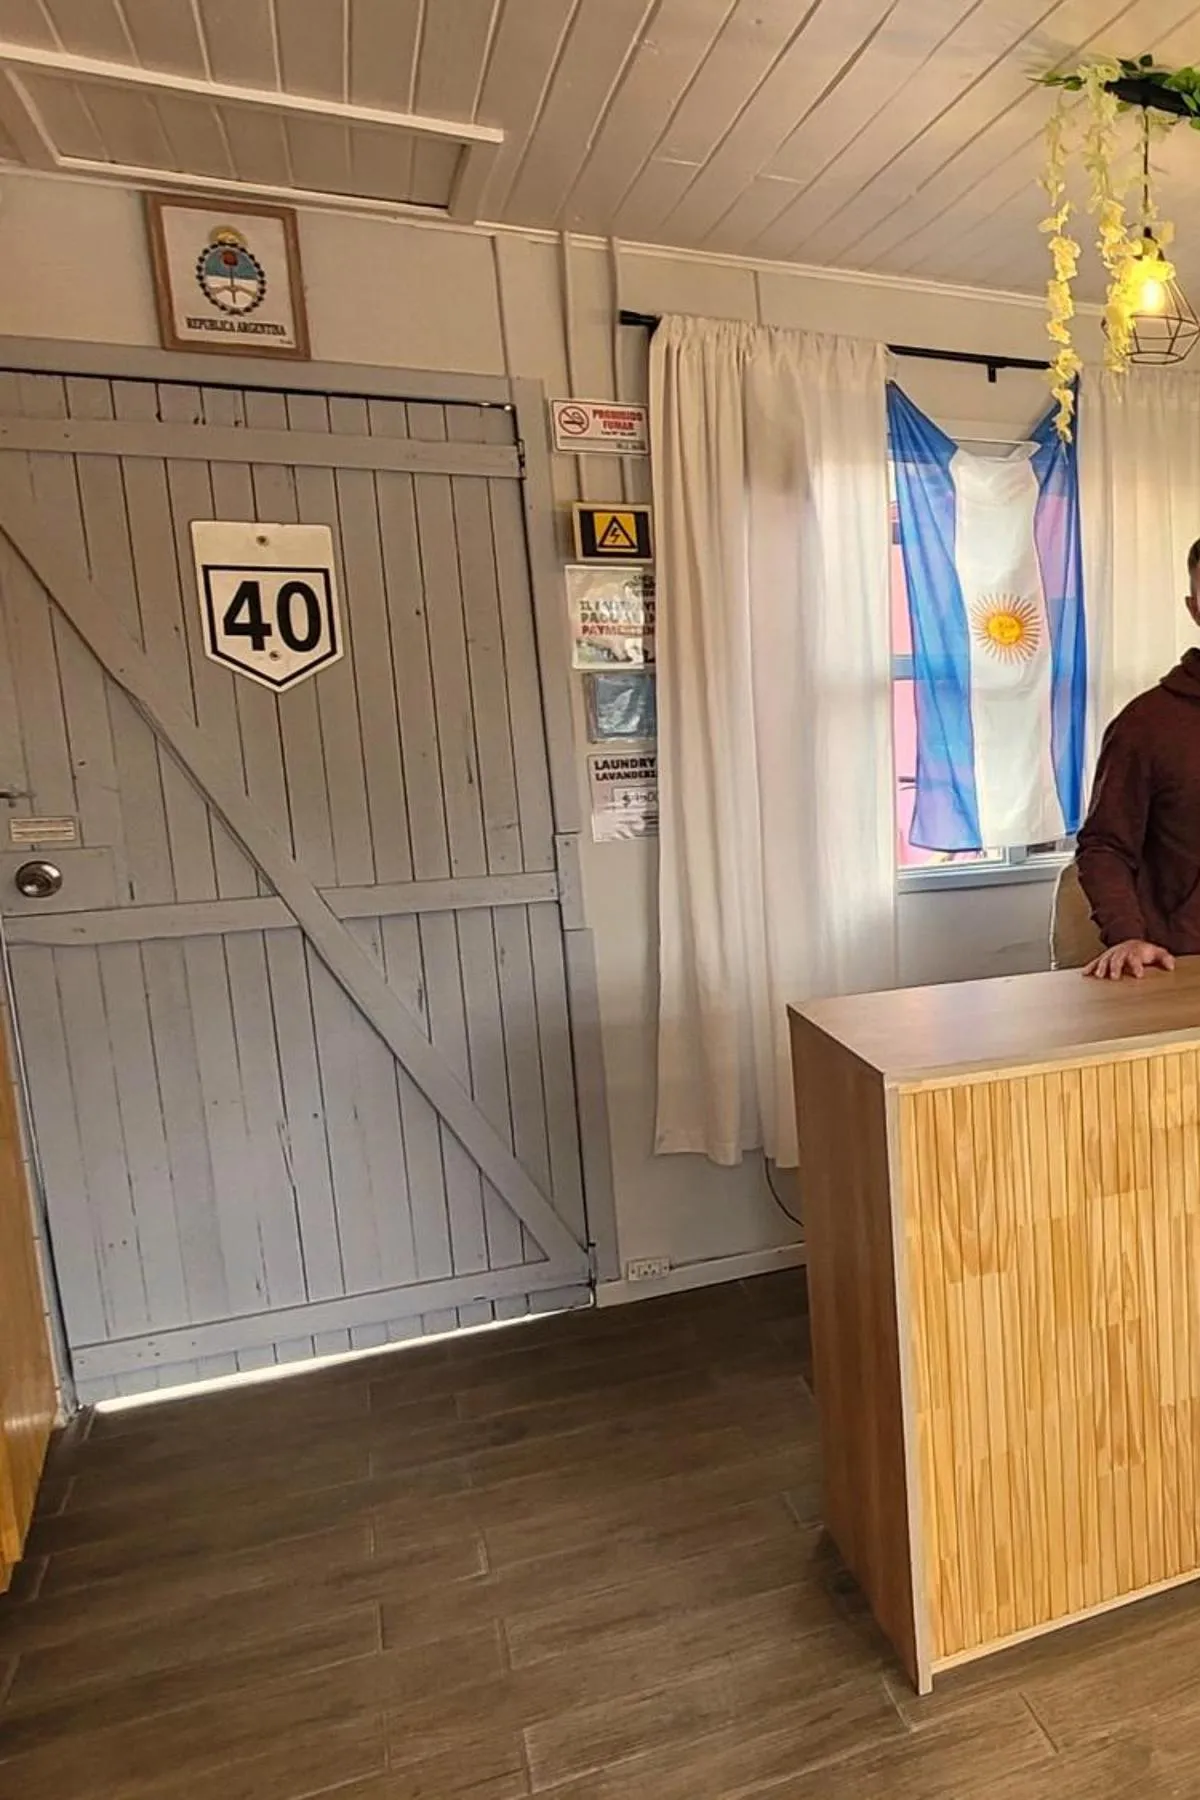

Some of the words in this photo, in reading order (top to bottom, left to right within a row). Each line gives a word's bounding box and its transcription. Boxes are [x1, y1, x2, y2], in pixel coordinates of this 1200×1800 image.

[236, 321, 287, 337] ARGENTINA
[592, 409, 643, 421] PROHIBIDO
[603, 420, 634, 430] FUMAR
[223, 580, 322, 653] 40
[594, 757, 656, 770] LAUNDRY
[595, 770, 656, 781] LAVANDERI
